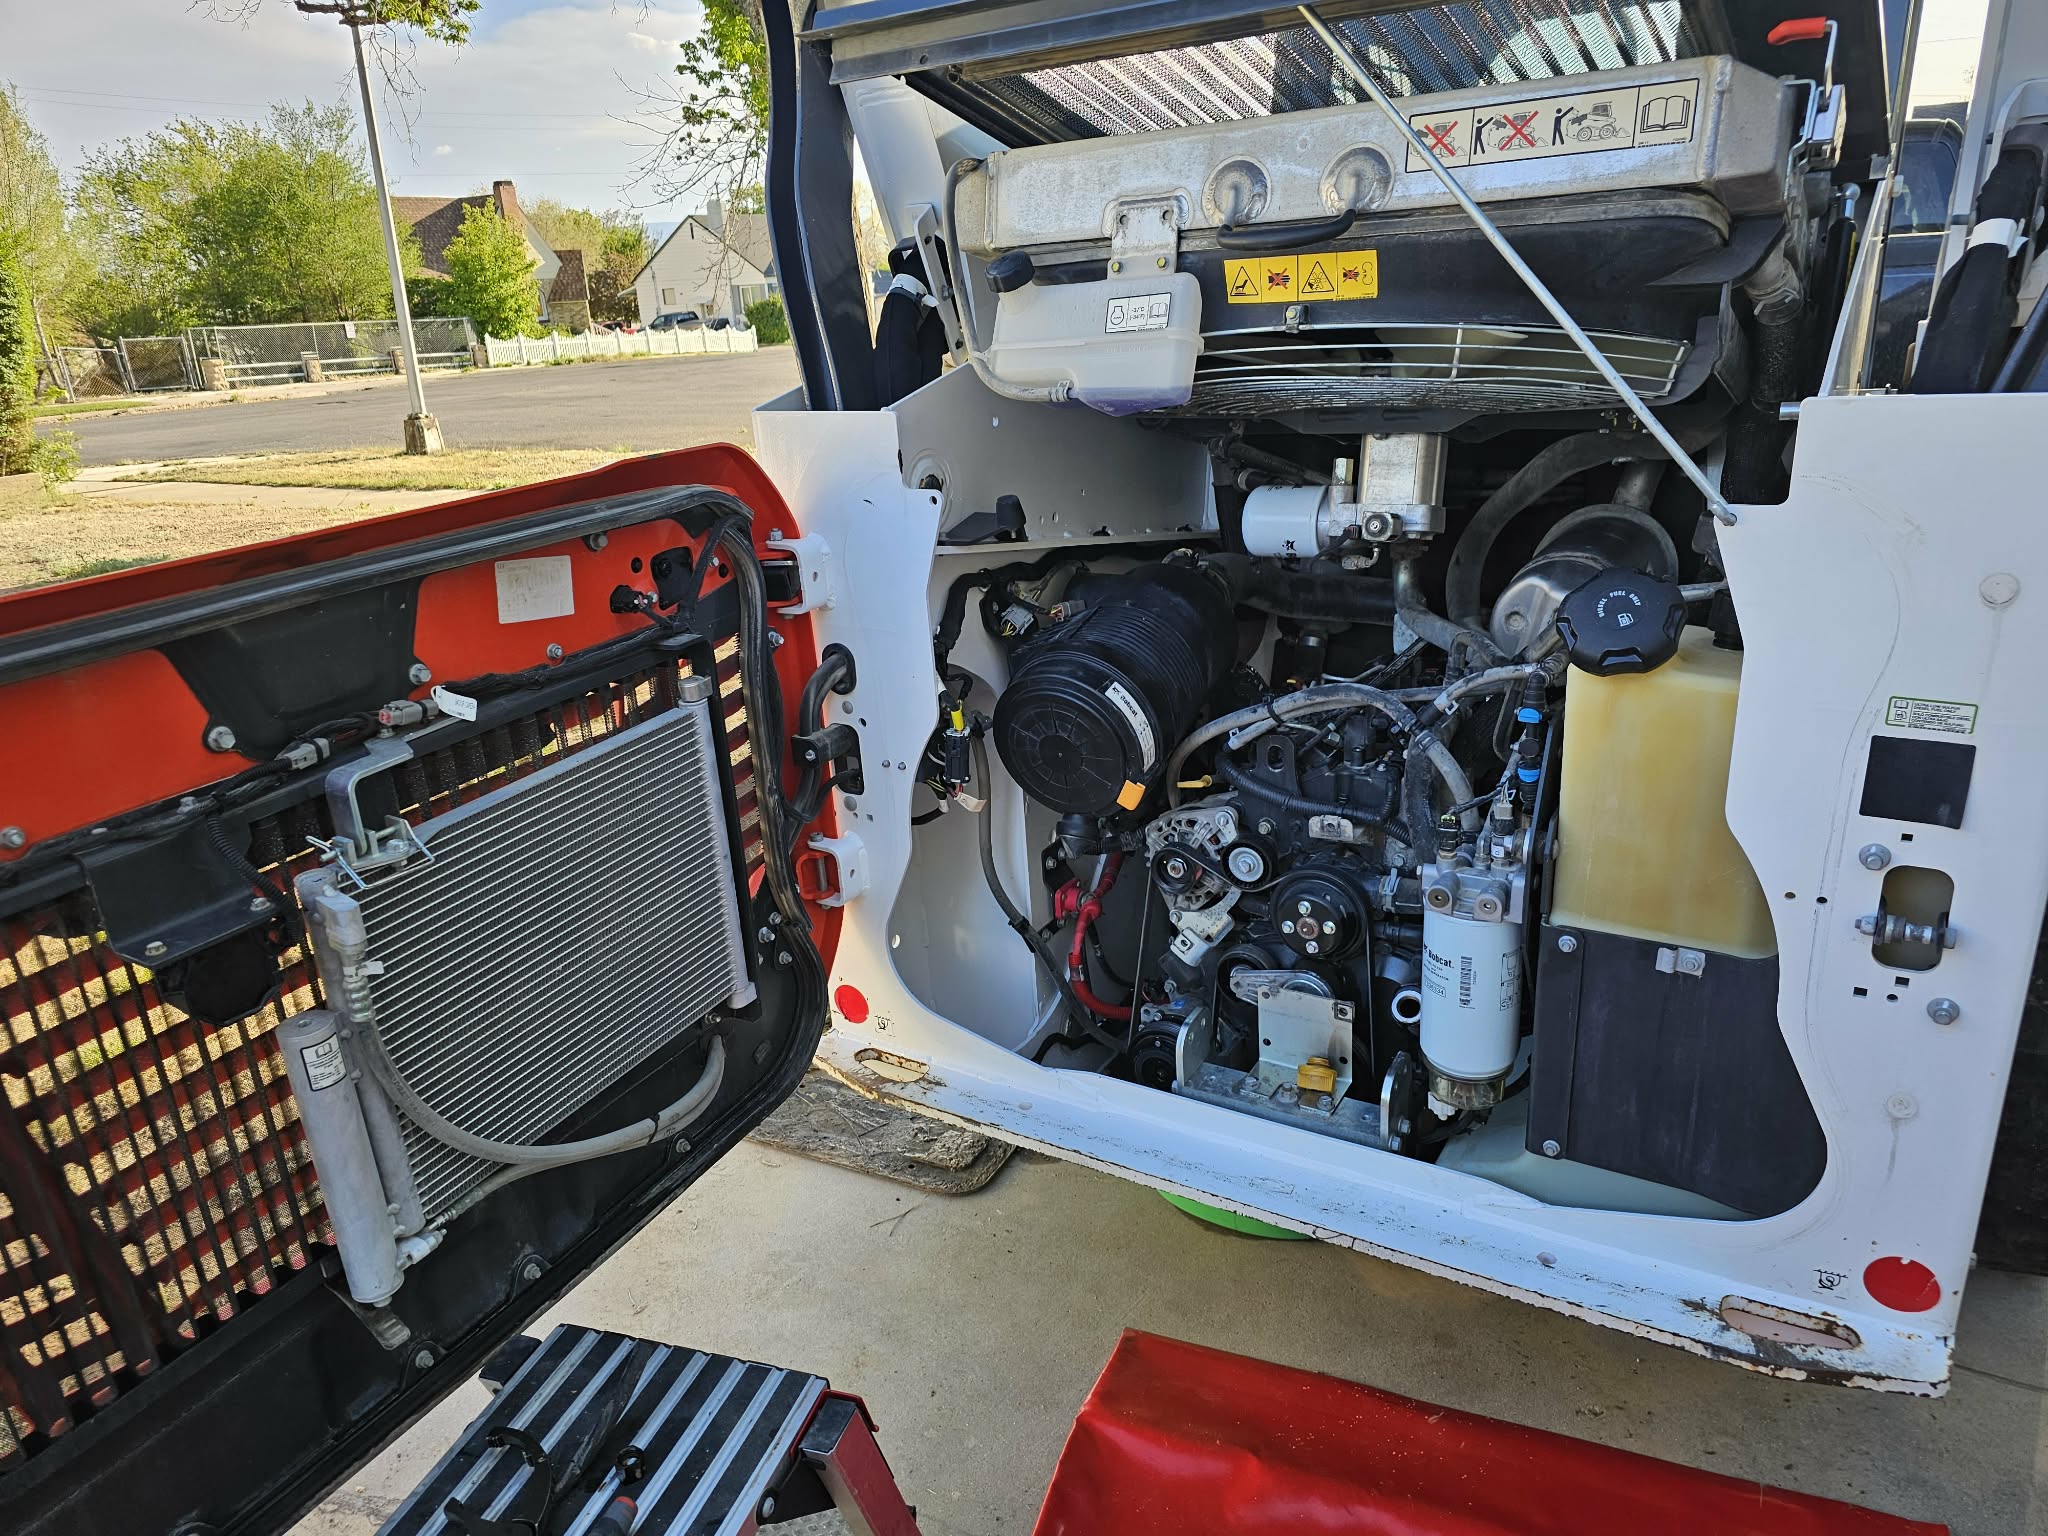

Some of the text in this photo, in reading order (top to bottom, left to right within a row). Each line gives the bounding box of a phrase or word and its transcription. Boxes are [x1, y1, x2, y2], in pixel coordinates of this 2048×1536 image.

[1596, 590, 1641, 618] DIESEL FUEL ONLY
[1120, 695, 1138, 717] Bobcat
[1428, 949, 1452, 969] Bobcat
